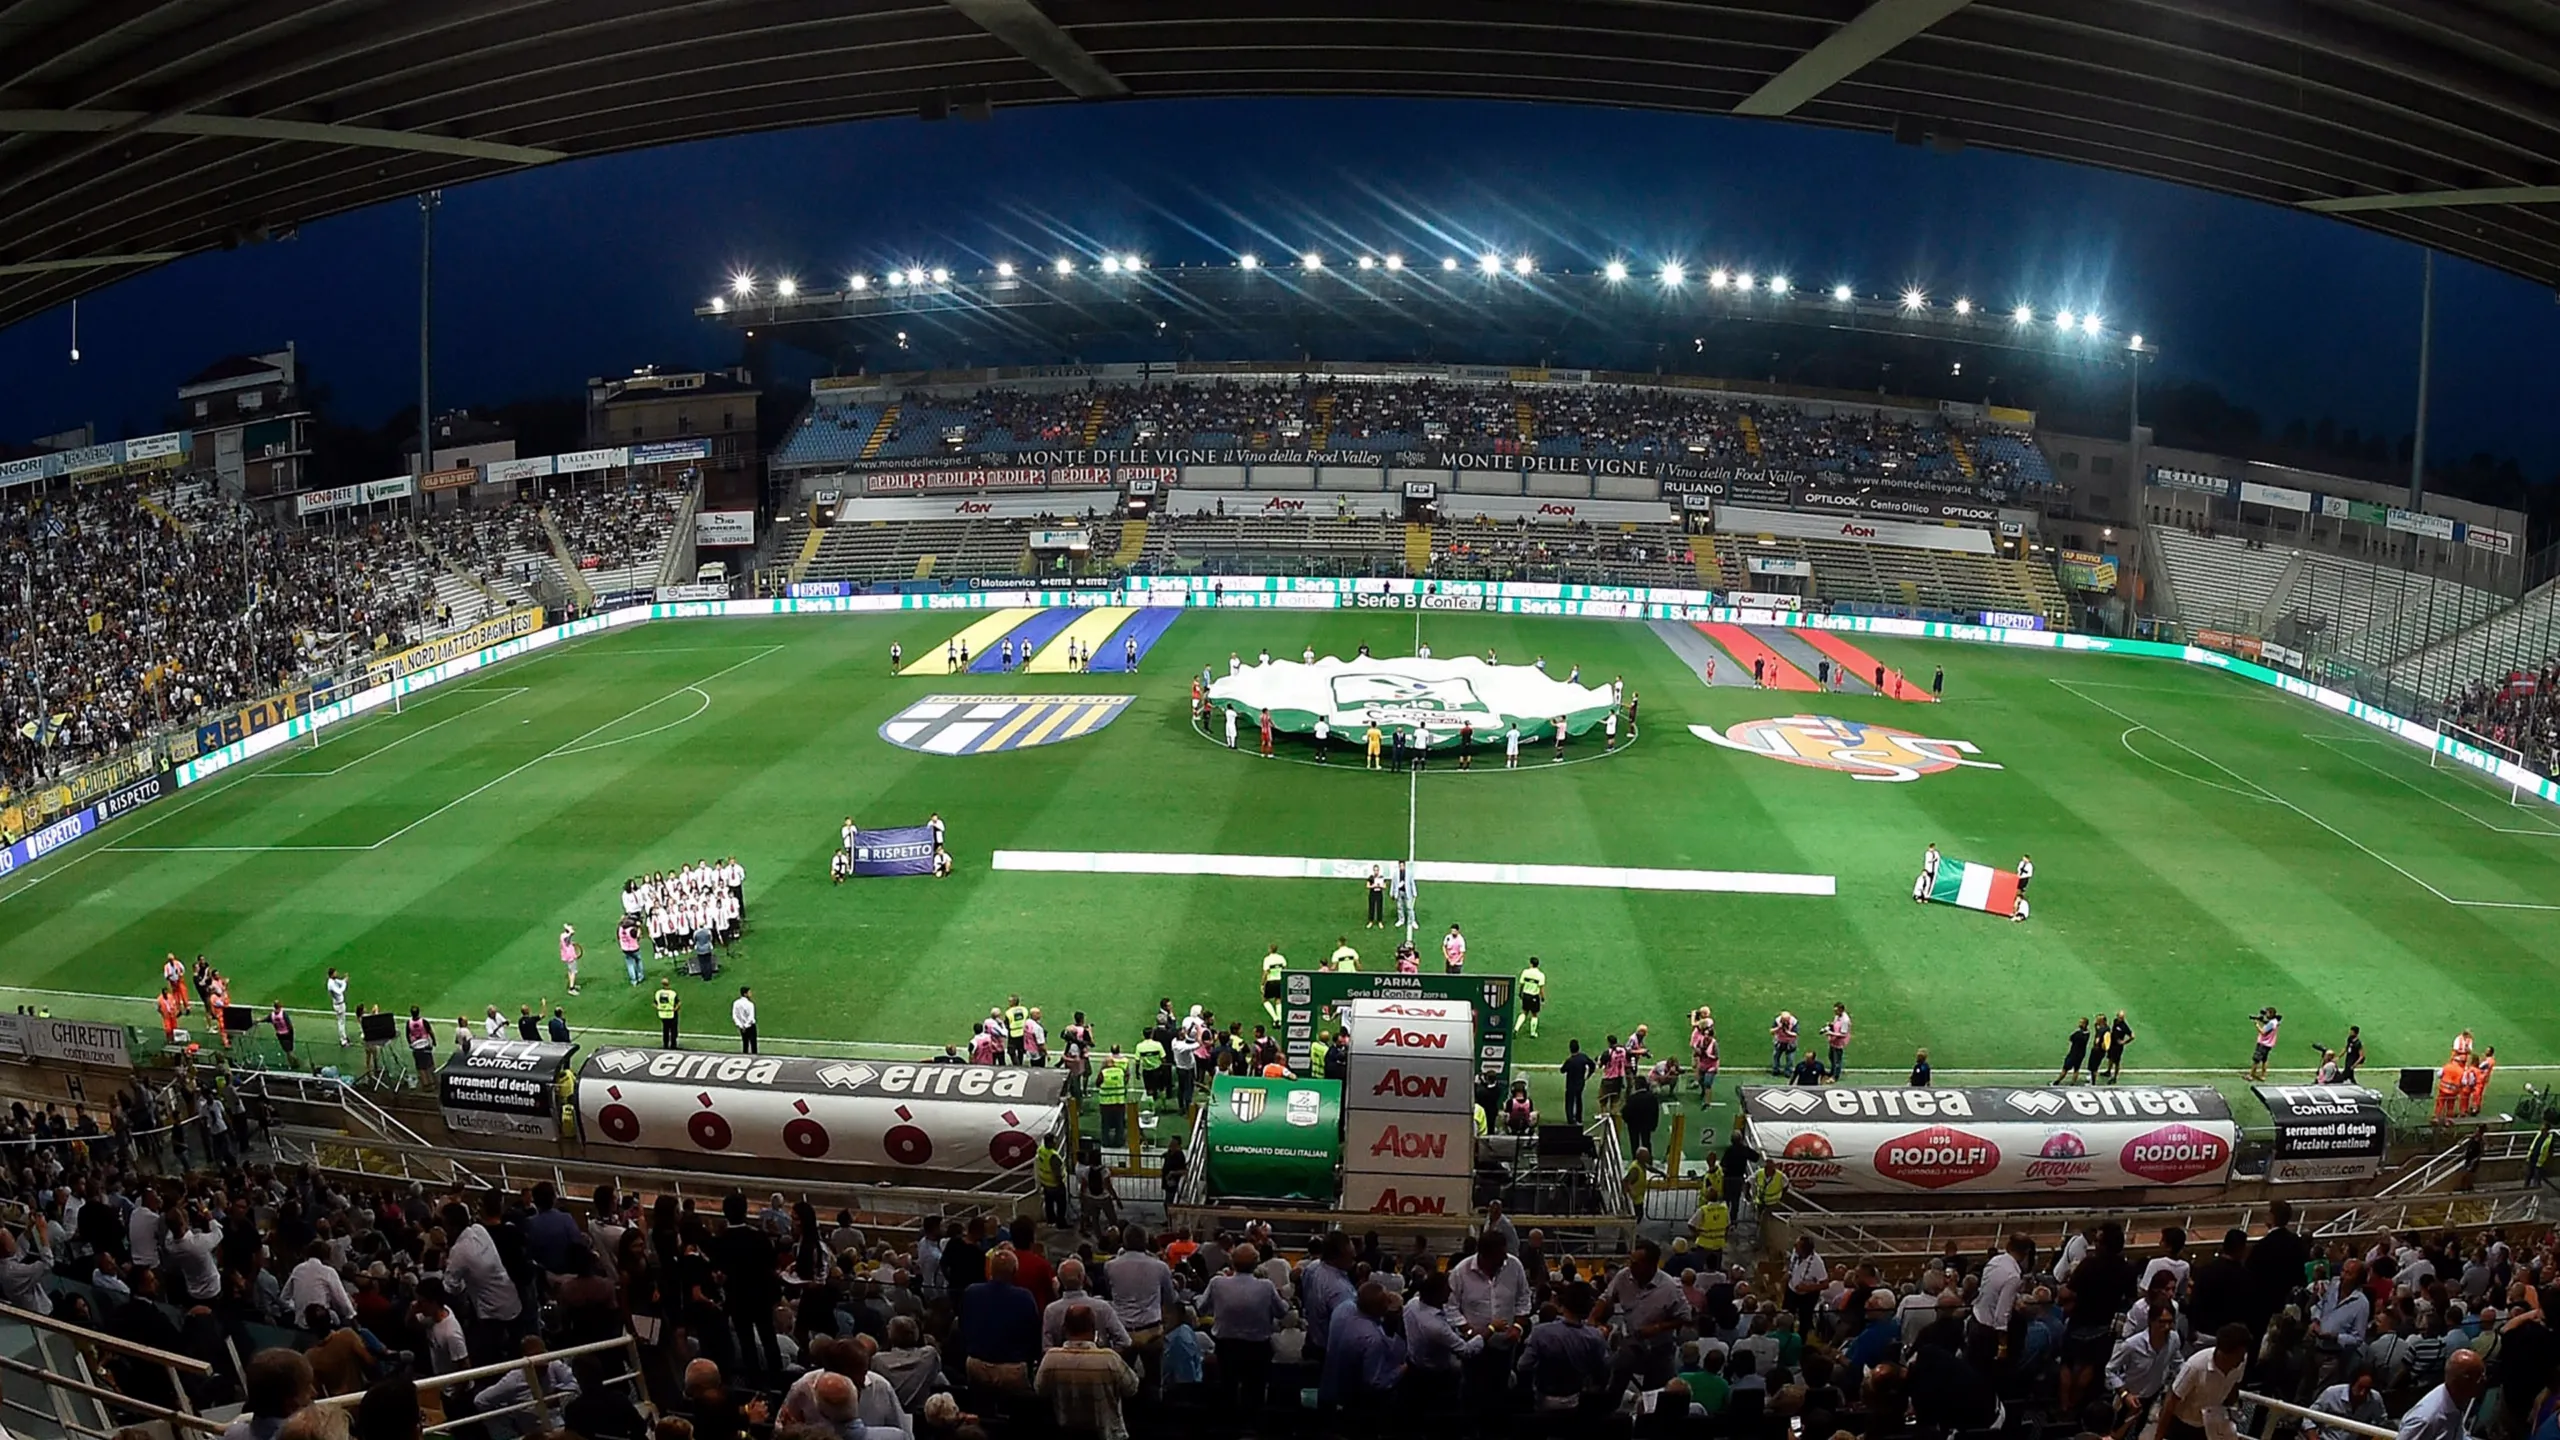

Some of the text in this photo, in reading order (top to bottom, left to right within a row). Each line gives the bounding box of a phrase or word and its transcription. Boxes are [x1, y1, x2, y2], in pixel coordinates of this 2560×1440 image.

[561, 452, 605, 464] VALENTI
[854, 456, 972, 470] www.montedellevigne.it
[1018, 451, 1086, 465] MONTE
[1094, 450, 1148, 464] DELLE
[1156, 450, 1216, 464] VIGNE
[1223, 451, 1233, 462] il
[1237, 450, 1266, 462] Vino
[1269, 450, 1302, 462] della
[1305, 450, 1337, 463] Food
[1343, 451, 1382, 465] Valley
[1440, 453, 1513, 469] MONTE
[1522, 456, 1579, 472] DELLE
[1586, 458, 1647, 475] VIGNE
[1655, 463, 1665, 475] il
[1668, 463, 1697, 478] Vino
[1700, 467, 1731, 480] della
[1734, 467, 1764, 482] Food
[1768, 470, 1807, 484] Valley
[425, 472, 475, 487] OLD WILD WEST
[1853, 476, 1972, 496] www.montedellevigne.it
[1664, 482, 1724, 494] RULIANO
[1805, 493, 1994, 520] OPTILOOK Centro Ottico OPTILOOK
[981, 579, 1036, 588] Motoservice
[1050, 578, 1071, 586] errea
[1086, 577, 1107, 586] errea
[1295, 578, 1334, 592] Serie
[1442, 581, 1482, 595] Serie
[801, 584, 839, 596] RISPETTO
[928, 595, 966, 609] Serie
[1357, 593, 1417, 608] Serie B
[1425, 595, 1478, 609] ConTe.it
[1520, 599, 1562, 614] Serie
[1994, 613, 2034, 629] RISPETTO
[408, 646, 436, 671] NORD
[438, 631, 478, 660] MATTEO
[110, 780, 161, 813] RISPETTO
[36, 818, 82, 851] RISPETTO
[873, 844, 932, 860] RISPETTO
[1374, 977, 1421, 987] PARMA
[1347, 989, 1371, 998] Serie
[1378, 1004, 1447, 1018] AON
[51, 1022, 122, 1049] GHIRETTI
[1375, 1027, 1448, 1049] AON
[63, 1047, 116, 1064] COSTRUZIONI
[466, 1057, 537, 1071] CONTRACT
[649, 1052, 783, 1084] errea
[65, 1073, 86, 1102] H
[449, 1075, 541, 1096] serramenti di design
[879, 1063, 1030, 1098] errea
[1372, 1069, 1449, 1098] AON
[457, 1088, 493, 1103] facciate
[494, 1093, 536, 1107] continue
[1824, 1089, 1973, 1116] errea
[2065, 1089, 2200, 1116] errea
[2292, 1104, 2360, 1115] CONTRACT
[1701, 1128, 1715, 1145] 2
[2285, 1122, 2376, 1138] serramenti di design
[1371, 1125, 1448, 1159] AON
[2292, 1138, 2330, 1151] facciate
[2331, 1137, 2371, 1149] continue
[1224, 1145, 1273, 1155] CAMPIONATO
[1274, 1147, 1296, 1156] DEGLI
[1297, 1148, 1328, 1158] ITALIANI
[1889, 1148, 1986, 1165] RODOLFI
[2133, 1145, 2217, 1162] RODOLFI
[2025, 1160, 2091, 1178] ORTOLINA
[1370, 1188, 1446, 1215] AON
